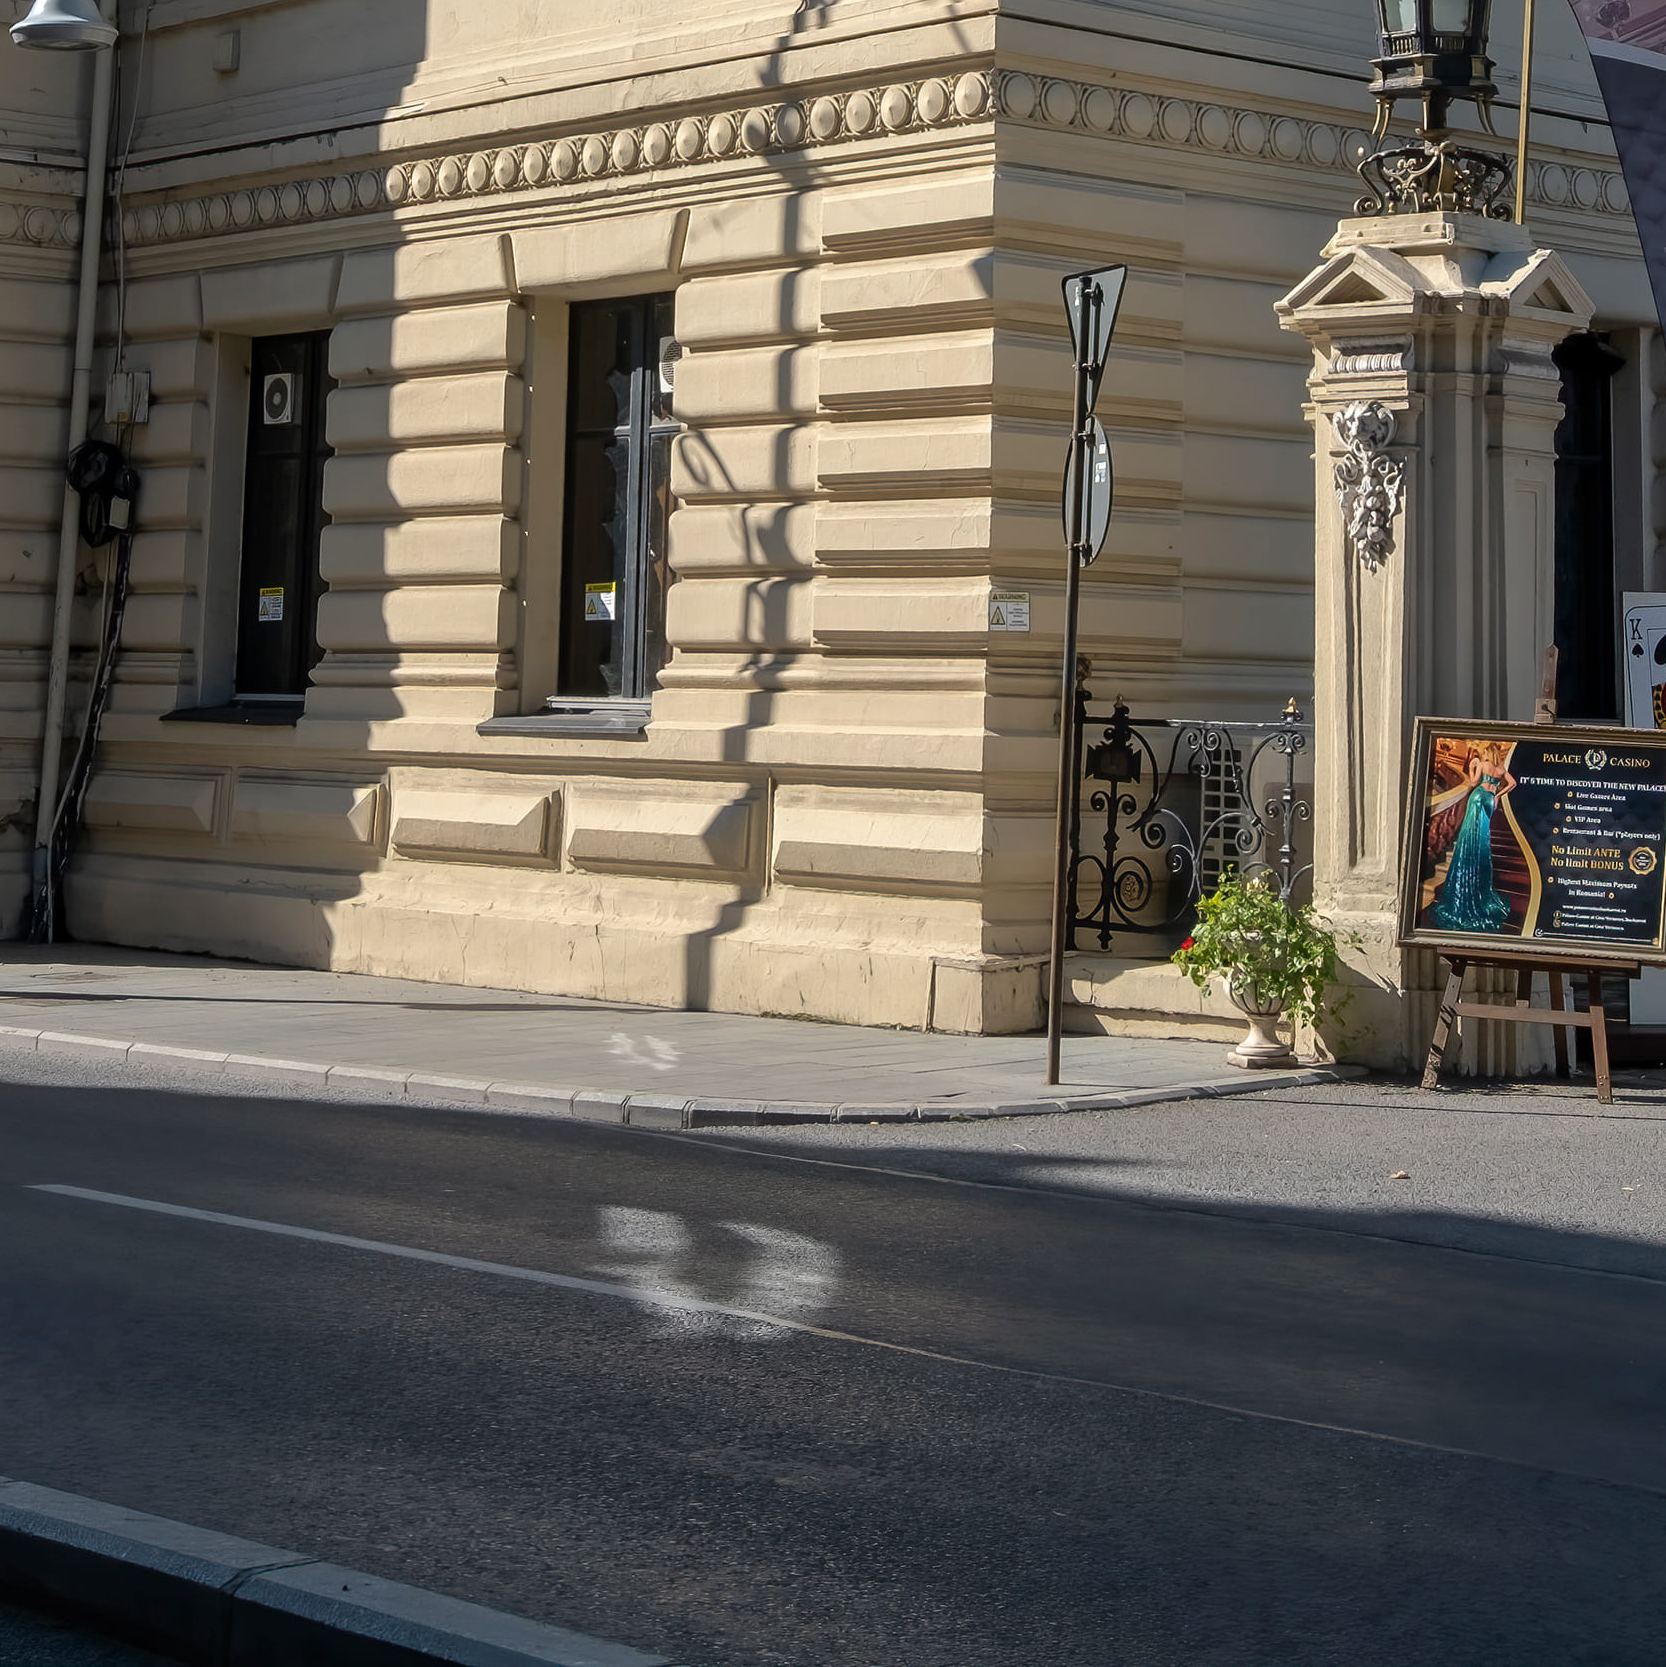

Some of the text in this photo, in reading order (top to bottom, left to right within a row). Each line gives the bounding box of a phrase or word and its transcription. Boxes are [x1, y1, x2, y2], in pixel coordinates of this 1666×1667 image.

[1629, 618, 1643, 640] K
[1543, 753, 1582, 764] PALACE
[1610, 757, 1651, 768] CASINO
[1536, 777, 1555, 787] TIME
[1556, 778, 1566, 786] TO
[1566, 779, 1602, 789] DISCOVER
[1603, 781, 1618, 790] THE
[1618, 782, 1637, 791] NEW
[1551, 845, 1621, 858] No Limit ANTE
[1550, 857, 1624, 871] No limit BONUS
